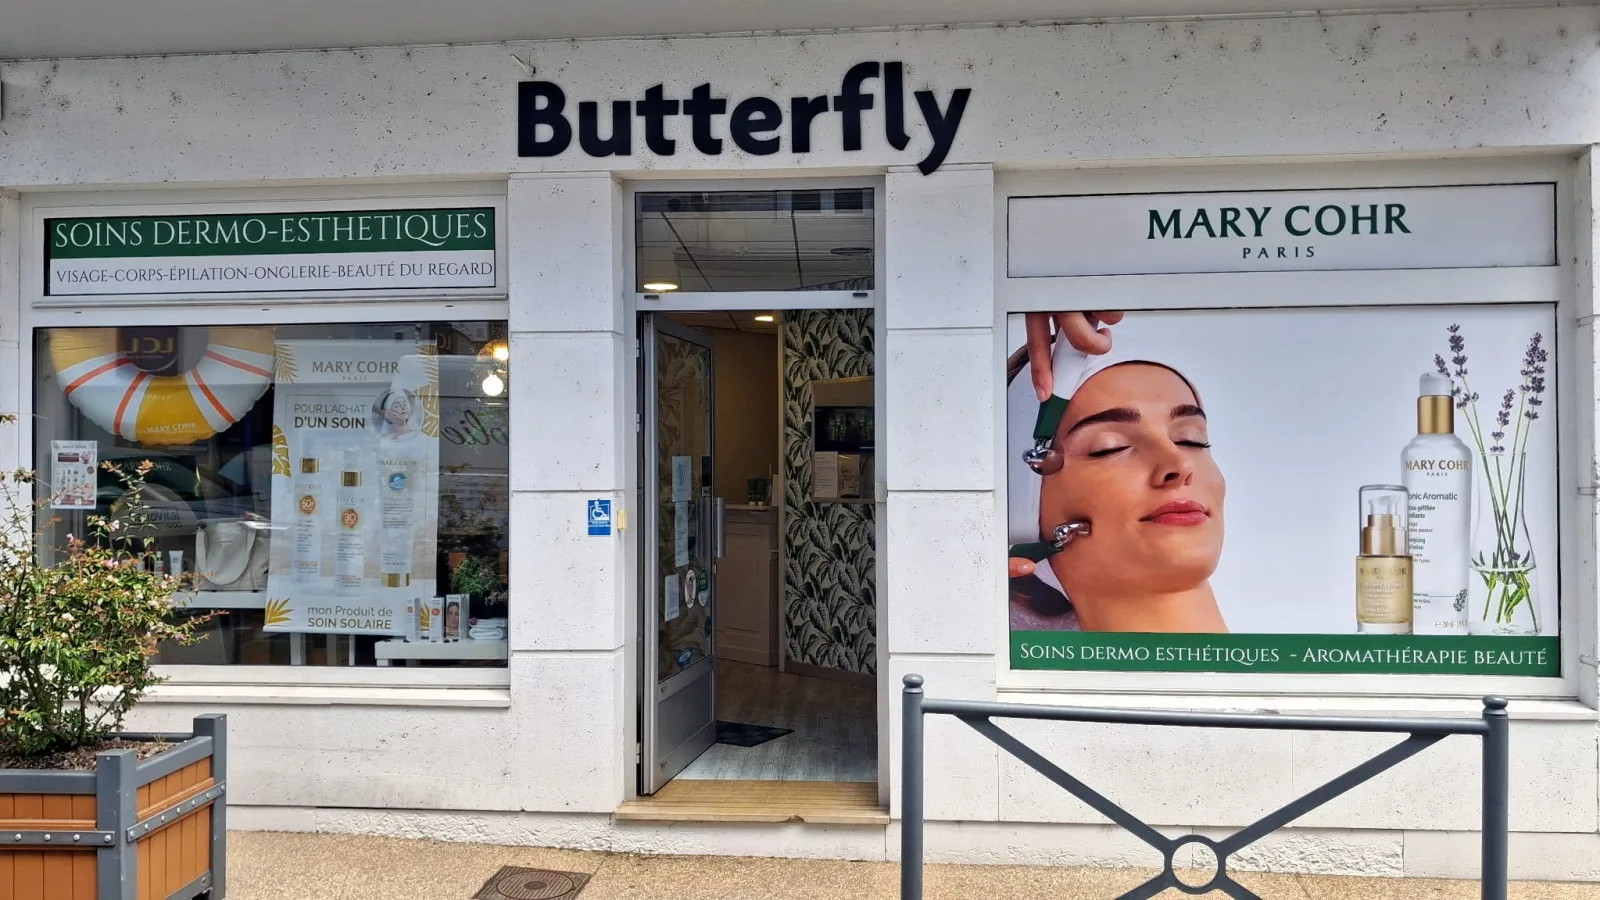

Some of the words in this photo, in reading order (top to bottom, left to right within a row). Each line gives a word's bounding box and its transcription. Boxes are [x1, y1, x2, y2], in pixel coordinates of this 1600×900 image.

[518, 61, 971, 176] Butterfly
[1147, 206, 1272, 239] MARY
[1284, 203, 1412, 236] COHR
[55, 221, 143, 248] SOINS
[152, 213, 487, 247] DERMO-ESTHETIQUES
[1242, 246, 1316, 259] PARIS
[56, 261, 396, 283] VISAGE-CORPS-ÉPILATION-ONGLERIE-BEAUTÉ
[400, 263, 423, 277] DU
[428, 262, 493, 276] REGARD
[312, 361, 354, 373] MARY
[357, 361, 400, 374] COHR
[294, 404, 323, 414] POUR
[324, 404, 366, 414] L'ACHAT
[147, 425, 171, 433] MARY
[172, 422, 197, 430] COHR
[294, 417, 328, 428] D'UN
[331, 417, 366, 429] SOIN
[1405, 460, 1435, 470] MARY
[1438, 460, 1469, 471] COHR
[1423, 492, 1458, 501] Aromatic
[343, 513, 357, 522] 30
[307, 606, 332, 615] mon
[335, 605, 375, 616] Produit
[377, 607, 393, 616] de
[307, 617, 337, 628] SOIN
[340, 618, 392, 629] SOLAIRE
[1020, 643, 1075, 660] SOINS
[1081, 646, 1150, 661] DERMO
[1155, 644, 1280, 666] ESTHÉTIQUES
[1302, 646, 1468, 664] AROMATHÉRAPIE
[1474, 647, 1547, 665] BEAUTÉ
